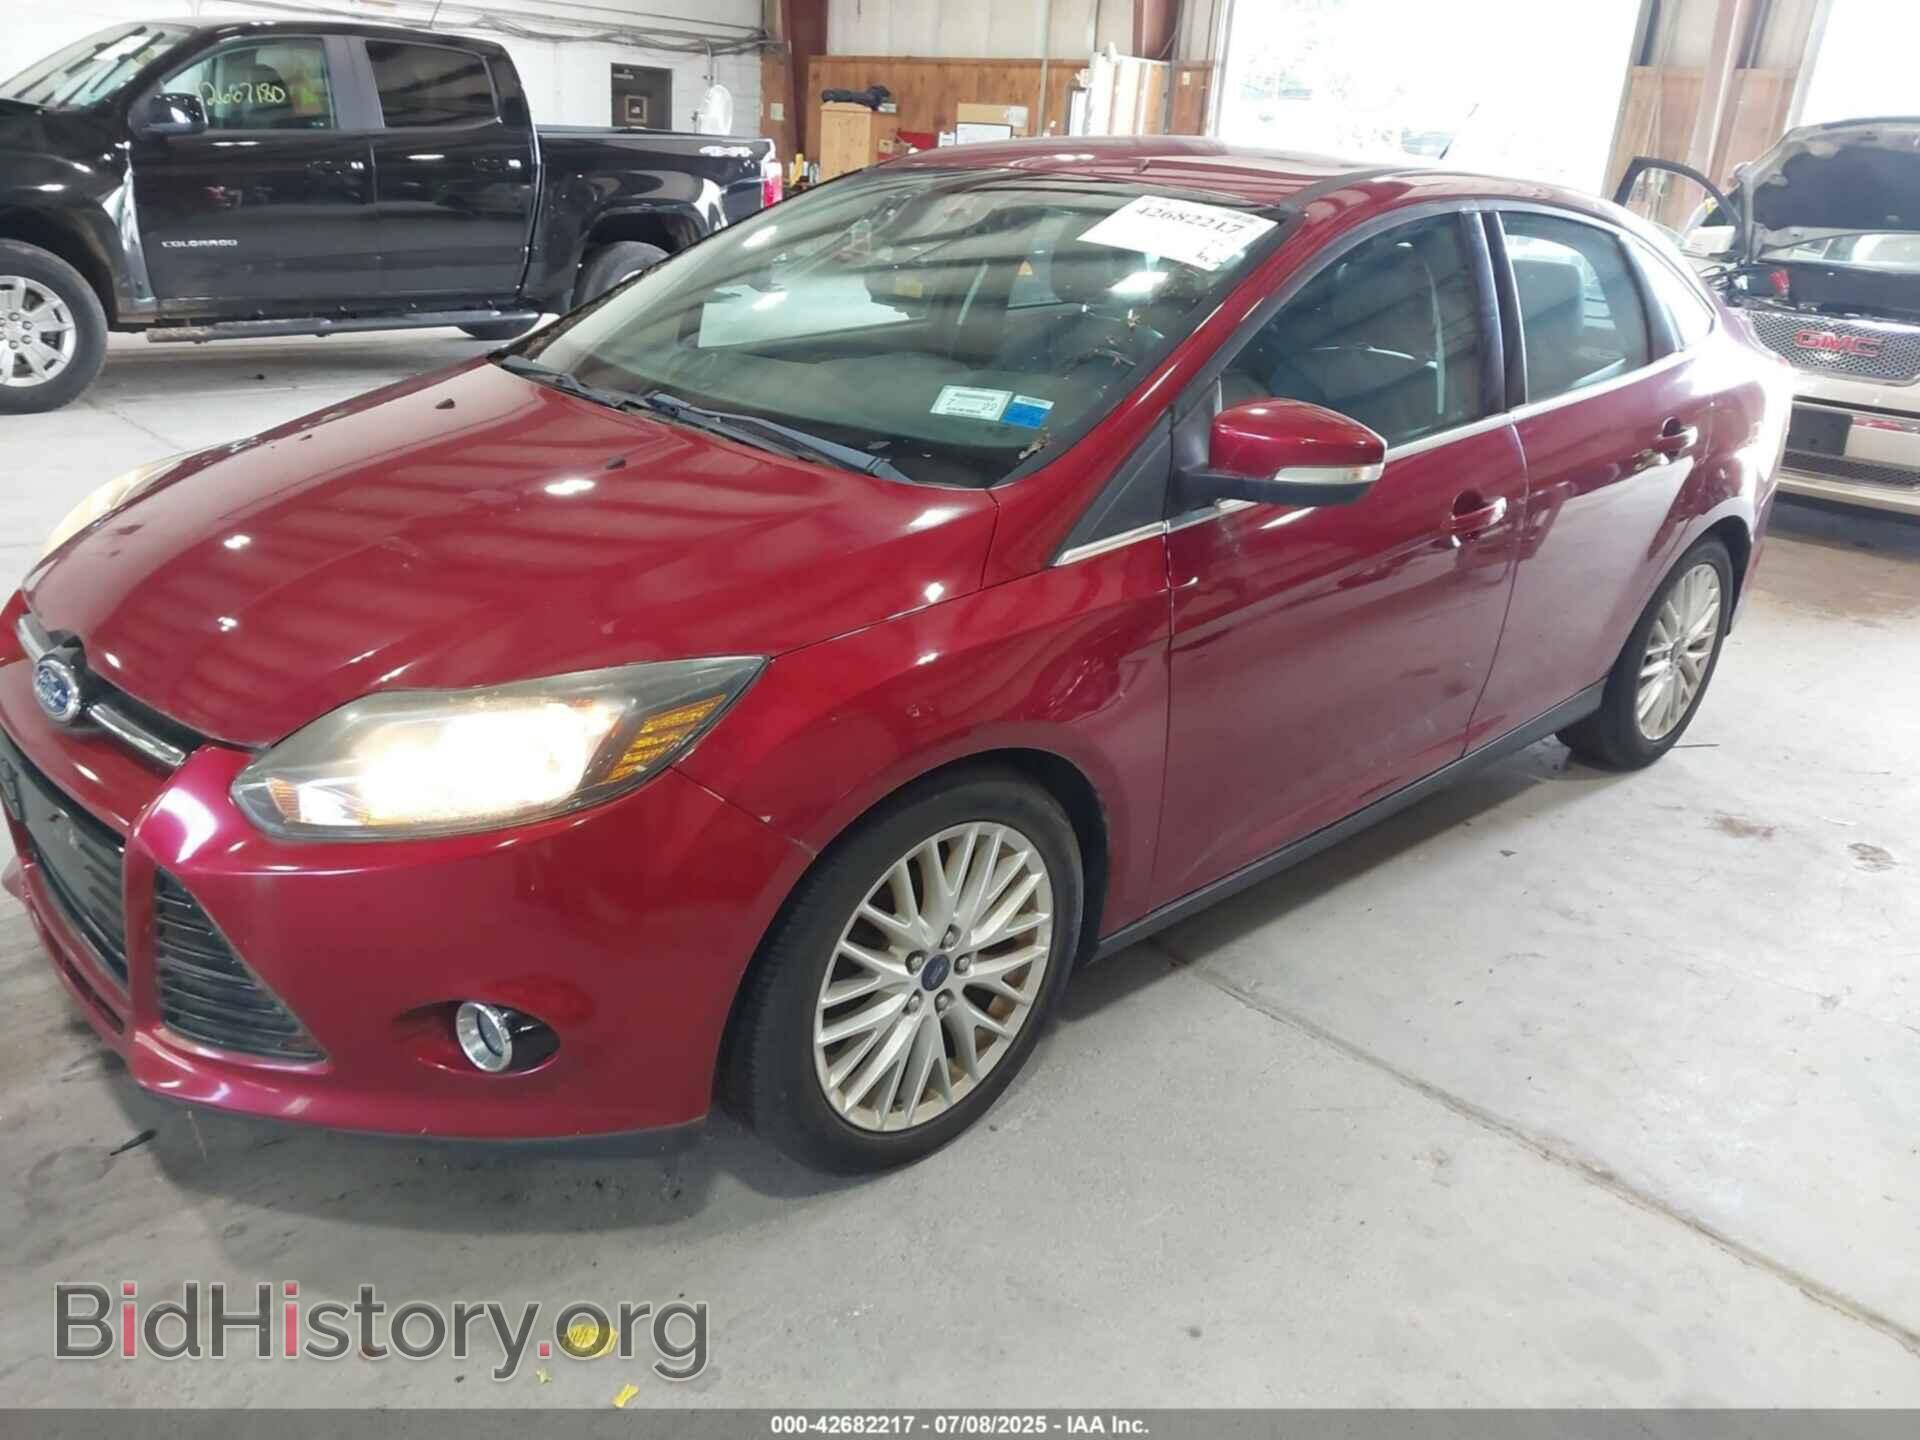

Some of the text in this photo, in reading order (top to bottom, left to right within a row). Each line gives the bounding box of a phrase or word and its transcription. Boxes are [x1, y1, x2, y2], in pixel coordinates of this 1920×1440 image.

[1136, 207, 1246, 234] 42682217
[161, 239, 238, 248] COLORADO
[1793, 328, 1882, 357] GMC
